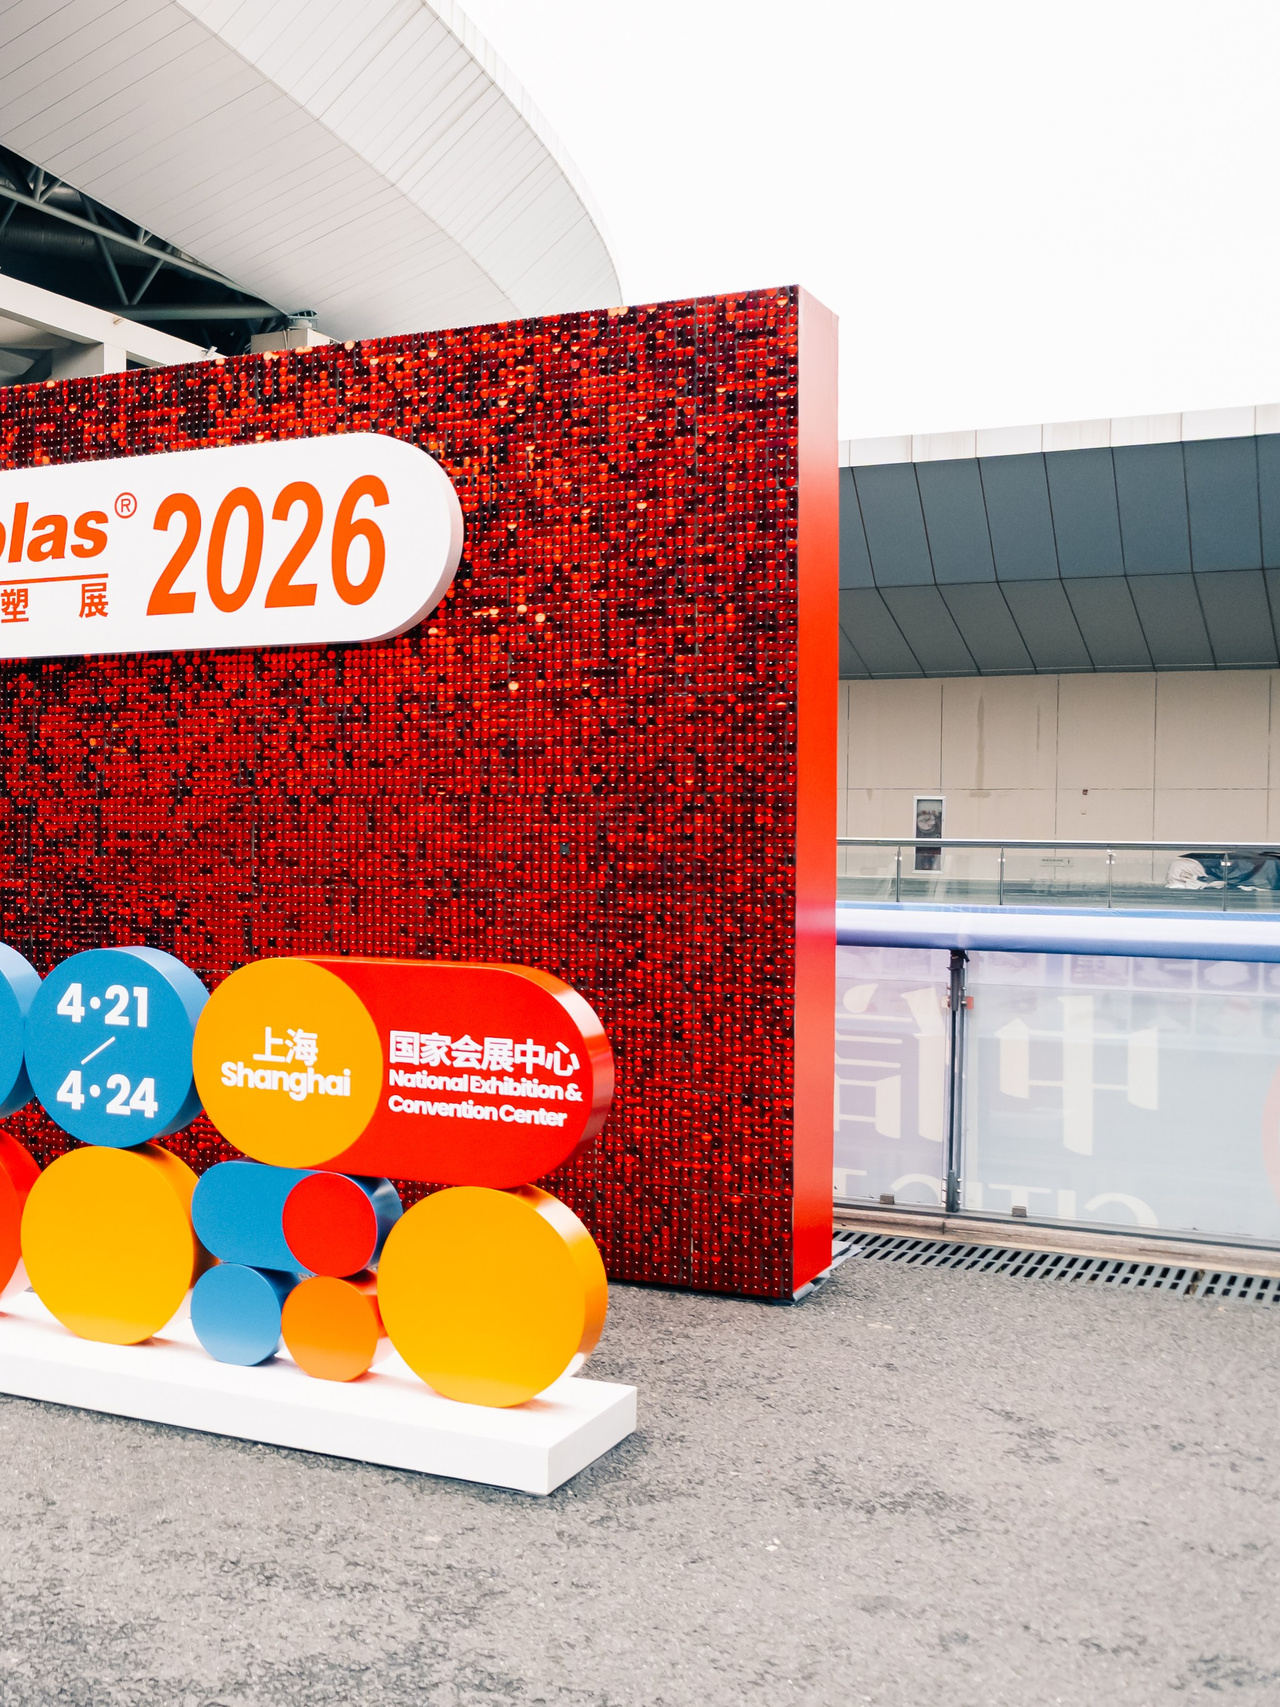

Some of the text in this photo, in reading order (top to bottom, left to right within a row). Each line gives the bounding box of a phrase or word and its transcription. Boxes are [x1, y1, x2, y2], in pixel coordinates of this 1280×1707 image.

[146, 474, 390, 616] 2026
[252, 1026, 319, 1067] 上海
[388, 1030, 580, 1077] 国家会展中心
[221, 1061, 351, 1101] Shanghai
[388, 1069, 583, 1102] National Exhibition &
[388, 1095, 568, 1128] Convention Center
